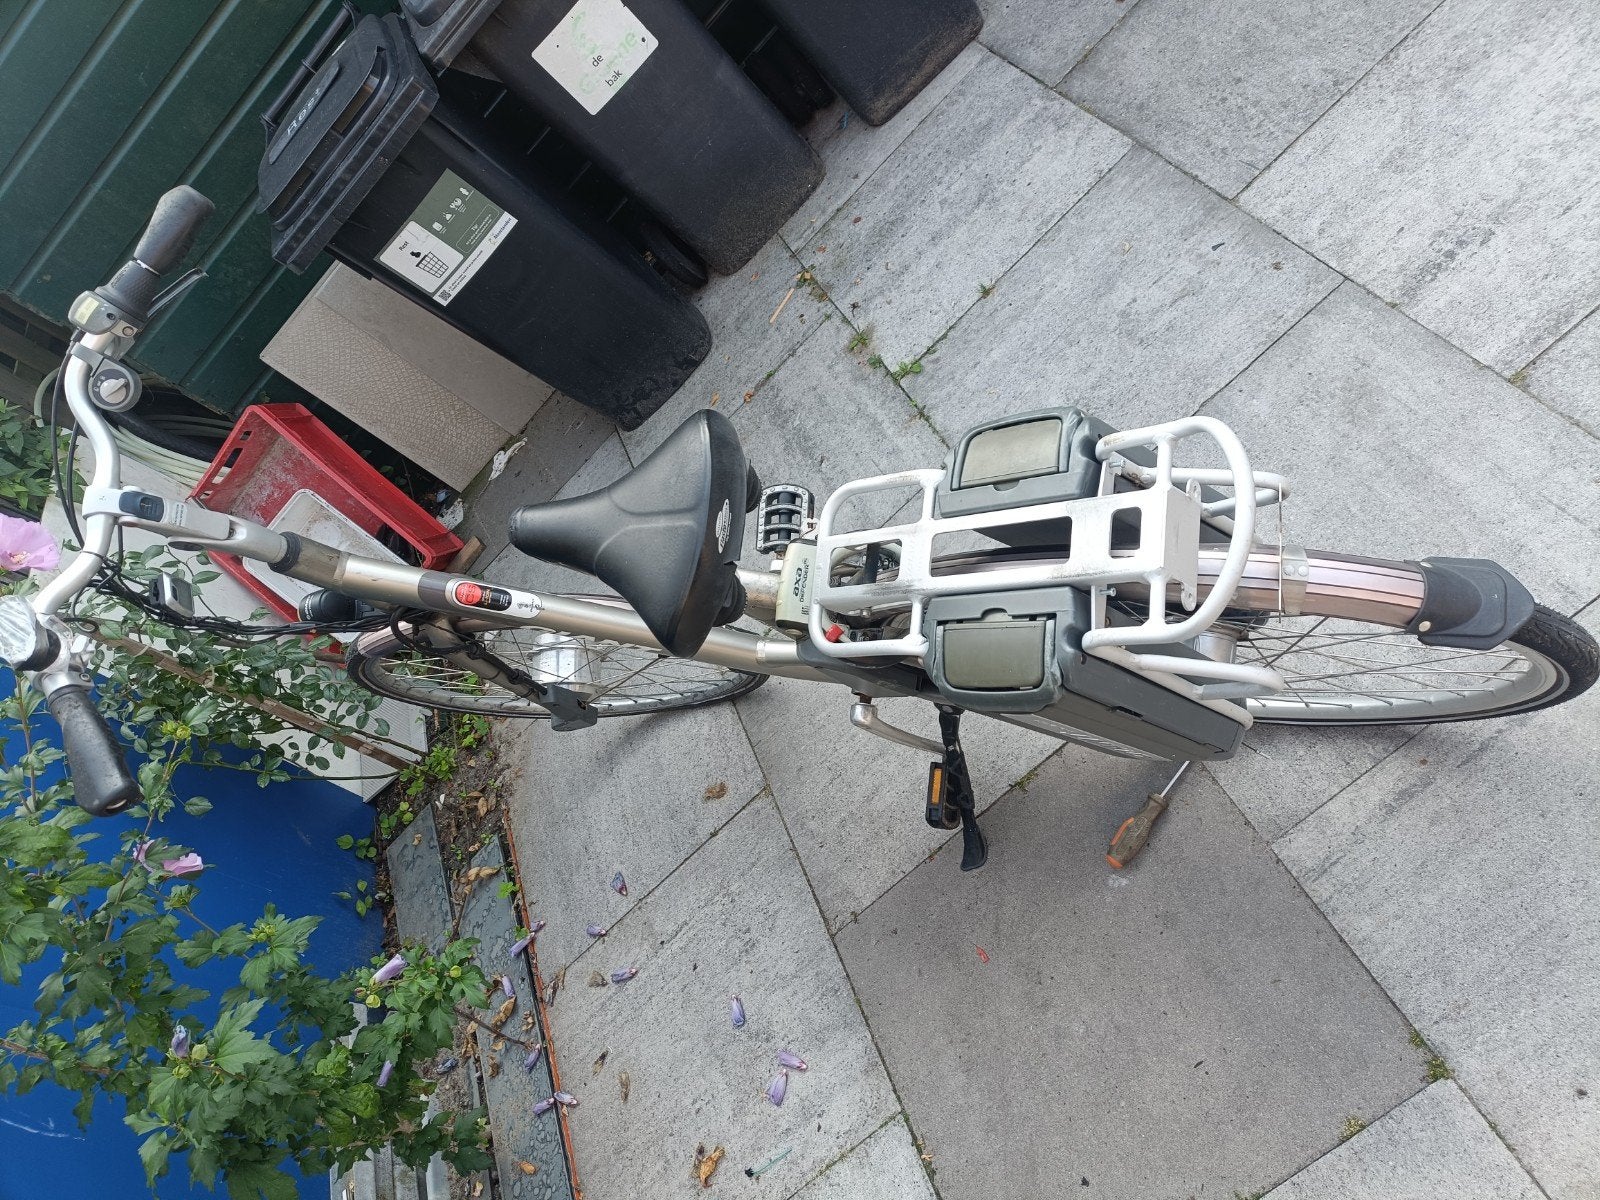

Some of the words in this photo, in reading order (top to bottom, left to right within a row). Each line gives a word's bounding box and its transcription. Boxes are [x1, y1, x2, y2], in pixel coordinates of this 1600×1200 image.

[592, 54, 604, 67] de
[605, 69, 623, 87] bak
[398, 240, 410, 252] Rest
[793, 567, 803, 597] axa
